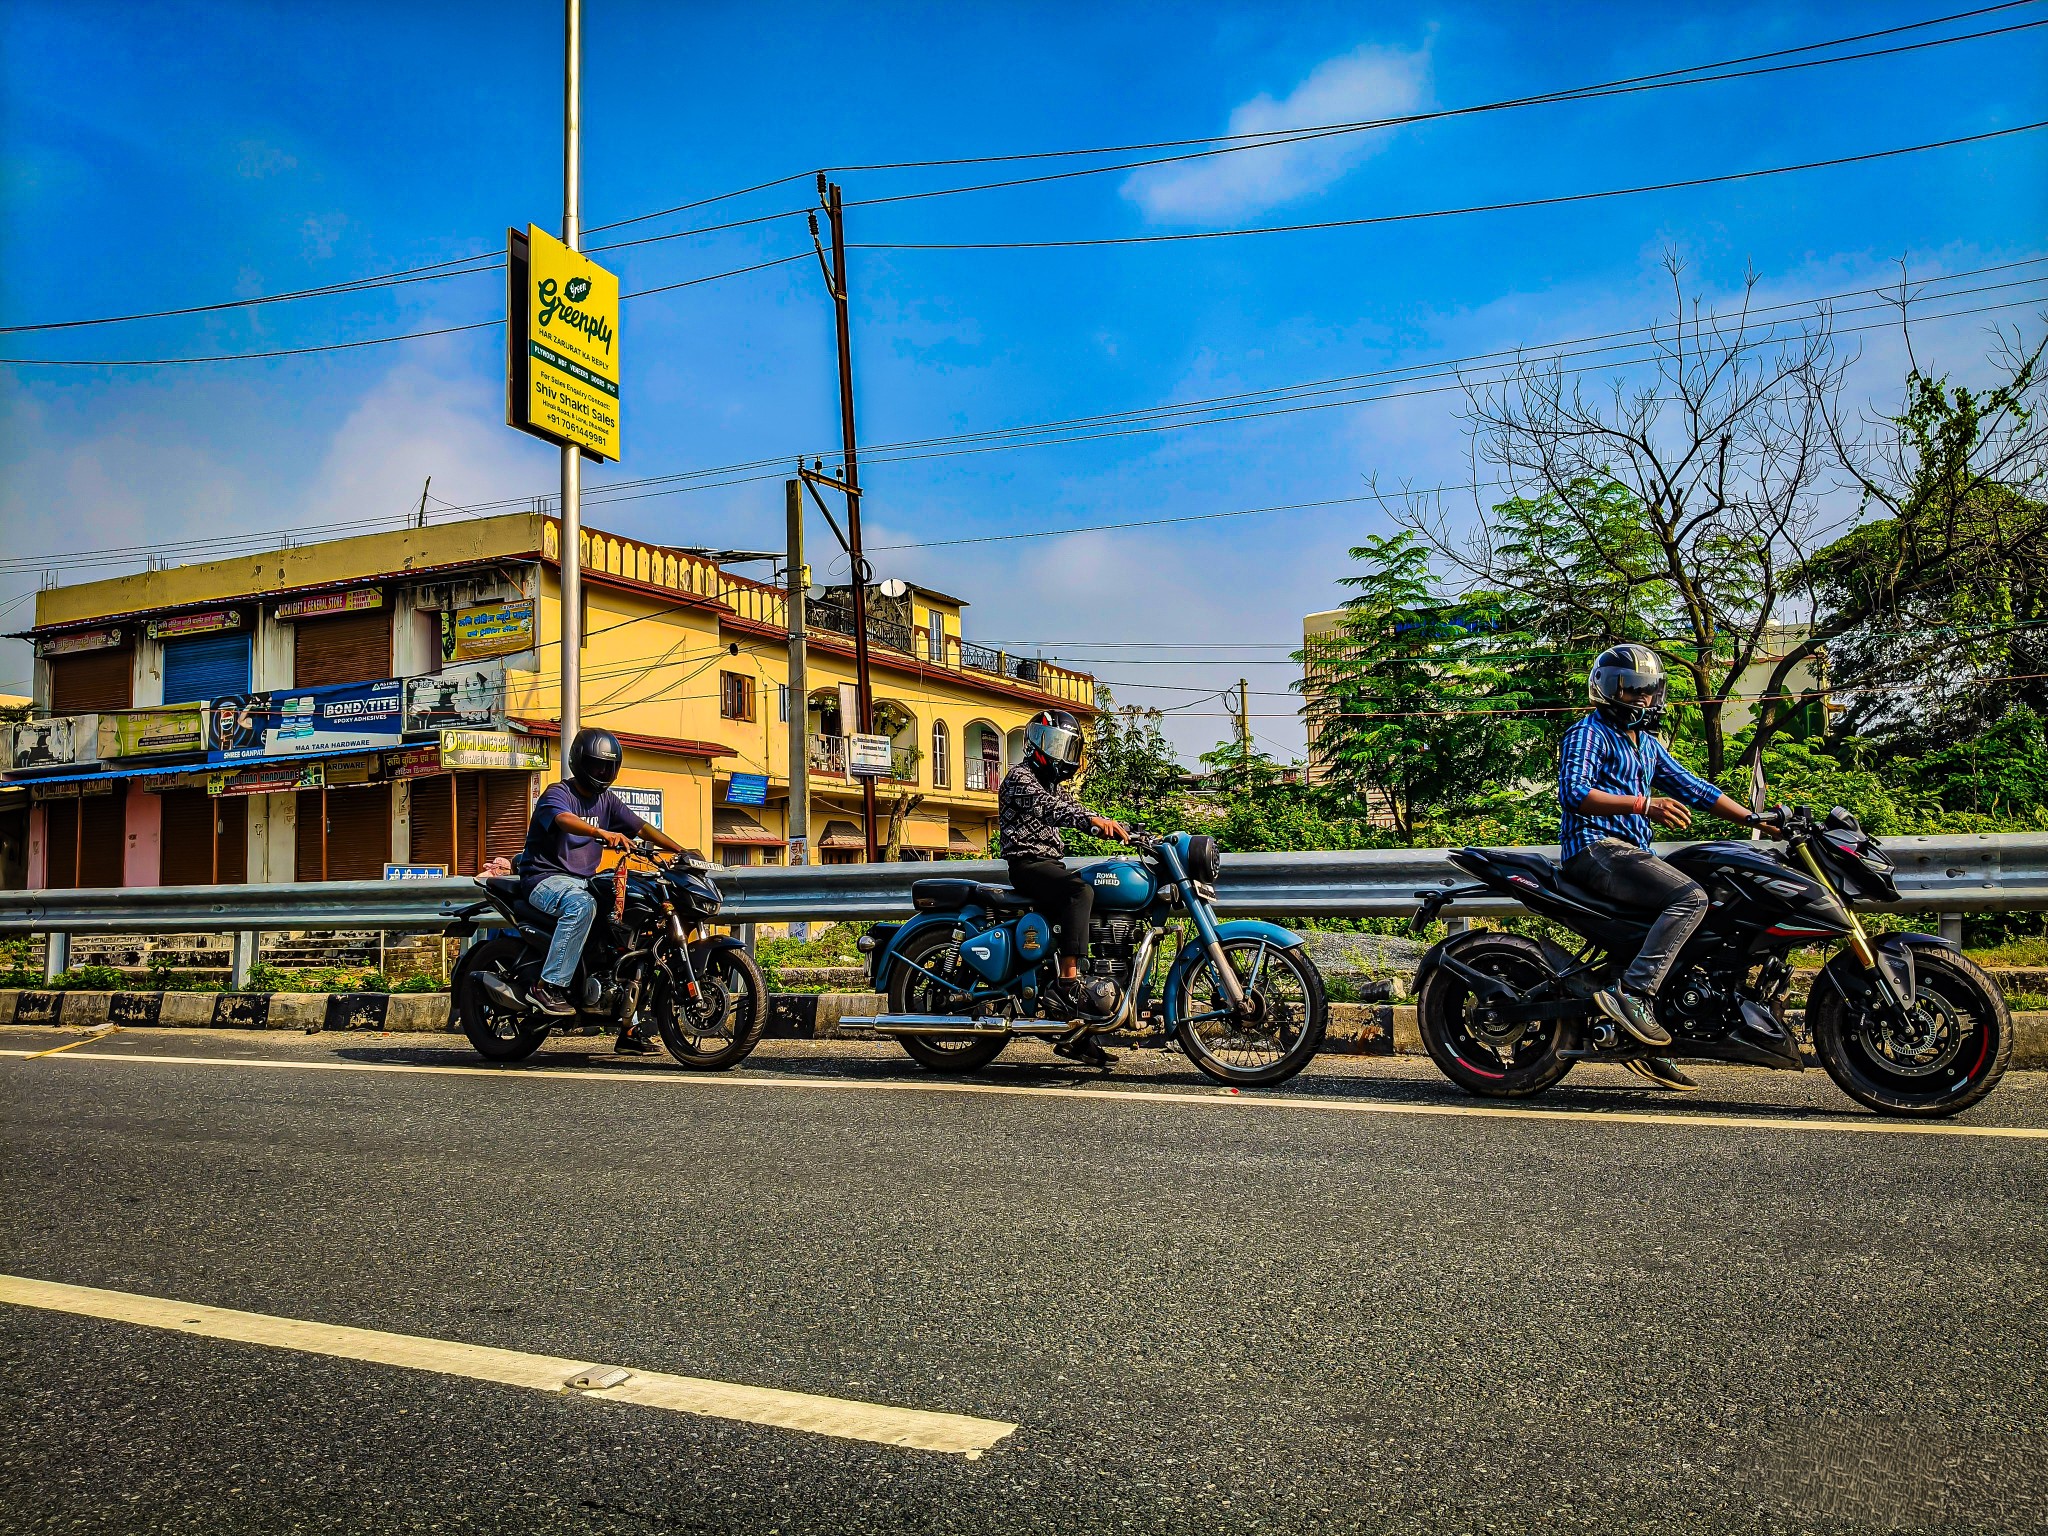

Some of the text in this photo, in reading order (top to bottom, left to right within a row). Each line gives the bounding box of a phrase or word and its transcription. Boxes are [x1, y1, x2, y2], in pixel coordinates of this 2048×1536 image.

[538, 278, 612, 355] Greenply
[538, 328, 609, 370] HAR ZARURAT KA REPLY
[540, 371, 550, 380] For
[551, 376, 566, 388] Sales
[566, 384, 587, 400] Enquiry
[536, 382, 615, 428] Shiv Shakti Sales
[328, 596, 343, 610] STORE
[334, 714, 387, 724] EPOXY ADHESIVES
[331, 740, 370, 748] HARDWARE
[224, 751, 240, 759] SHREE
[631, 792, 660, 806] TRADERS
